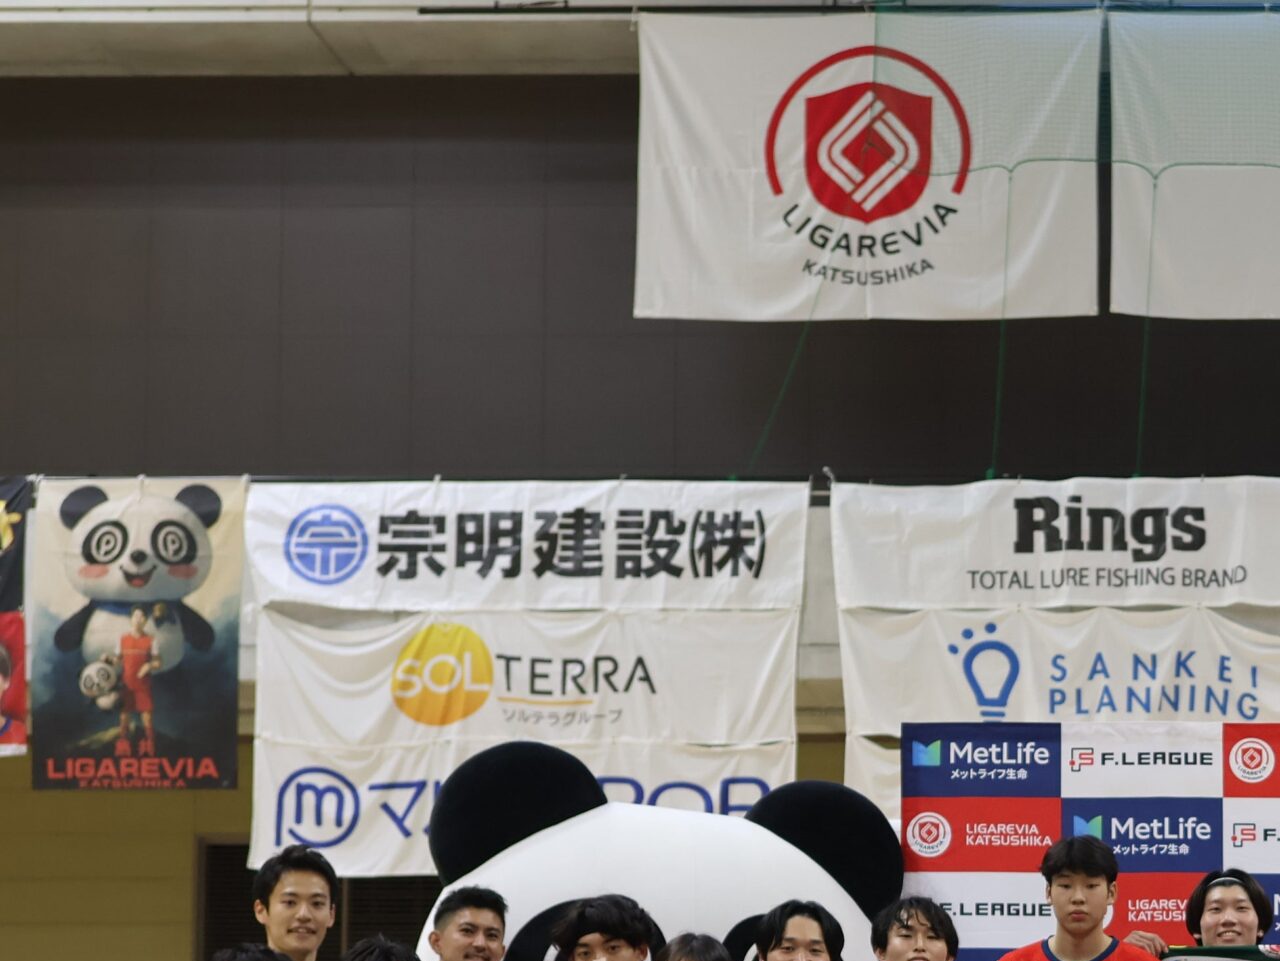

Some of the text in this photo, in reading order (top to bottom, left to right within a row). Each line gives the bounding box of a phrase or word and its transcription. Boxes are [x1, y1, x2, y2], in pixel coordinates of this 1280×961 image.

[782, 203, 958, 258] LIGAREVIA
[802, 258, 934, 286] KATSUSHIKA
[1013, 496, 1207, 562] Rings
[967, 564, 1248, 590] TOTAL LURE FISHING BRAND
[393, 653, 656, 699] SOL TERRA
[1048, 650, 1259, 689] SANKEI
[1048, 684, 1260, 721] PLANNING
[502, 707, 623, 729] ソルテラグループ
[950, 741, 1049, 765] MetLife
[1101, 751, 1213, 766] F.LEAGUE
[47, 757, 219, 779] LIGAREVIA
[951, 768, 1028, 780] メットライフ生命
[966, 823, 1038, 834] LIGAREVIA
[1111, 816, 1211, 840] MetLife
[966, 835, 1052, 847] KATSUSHIKA
[1113, 843, 1190, 855] メットライフ生命
[1128, 899, 1187, 910] LIGAREV
